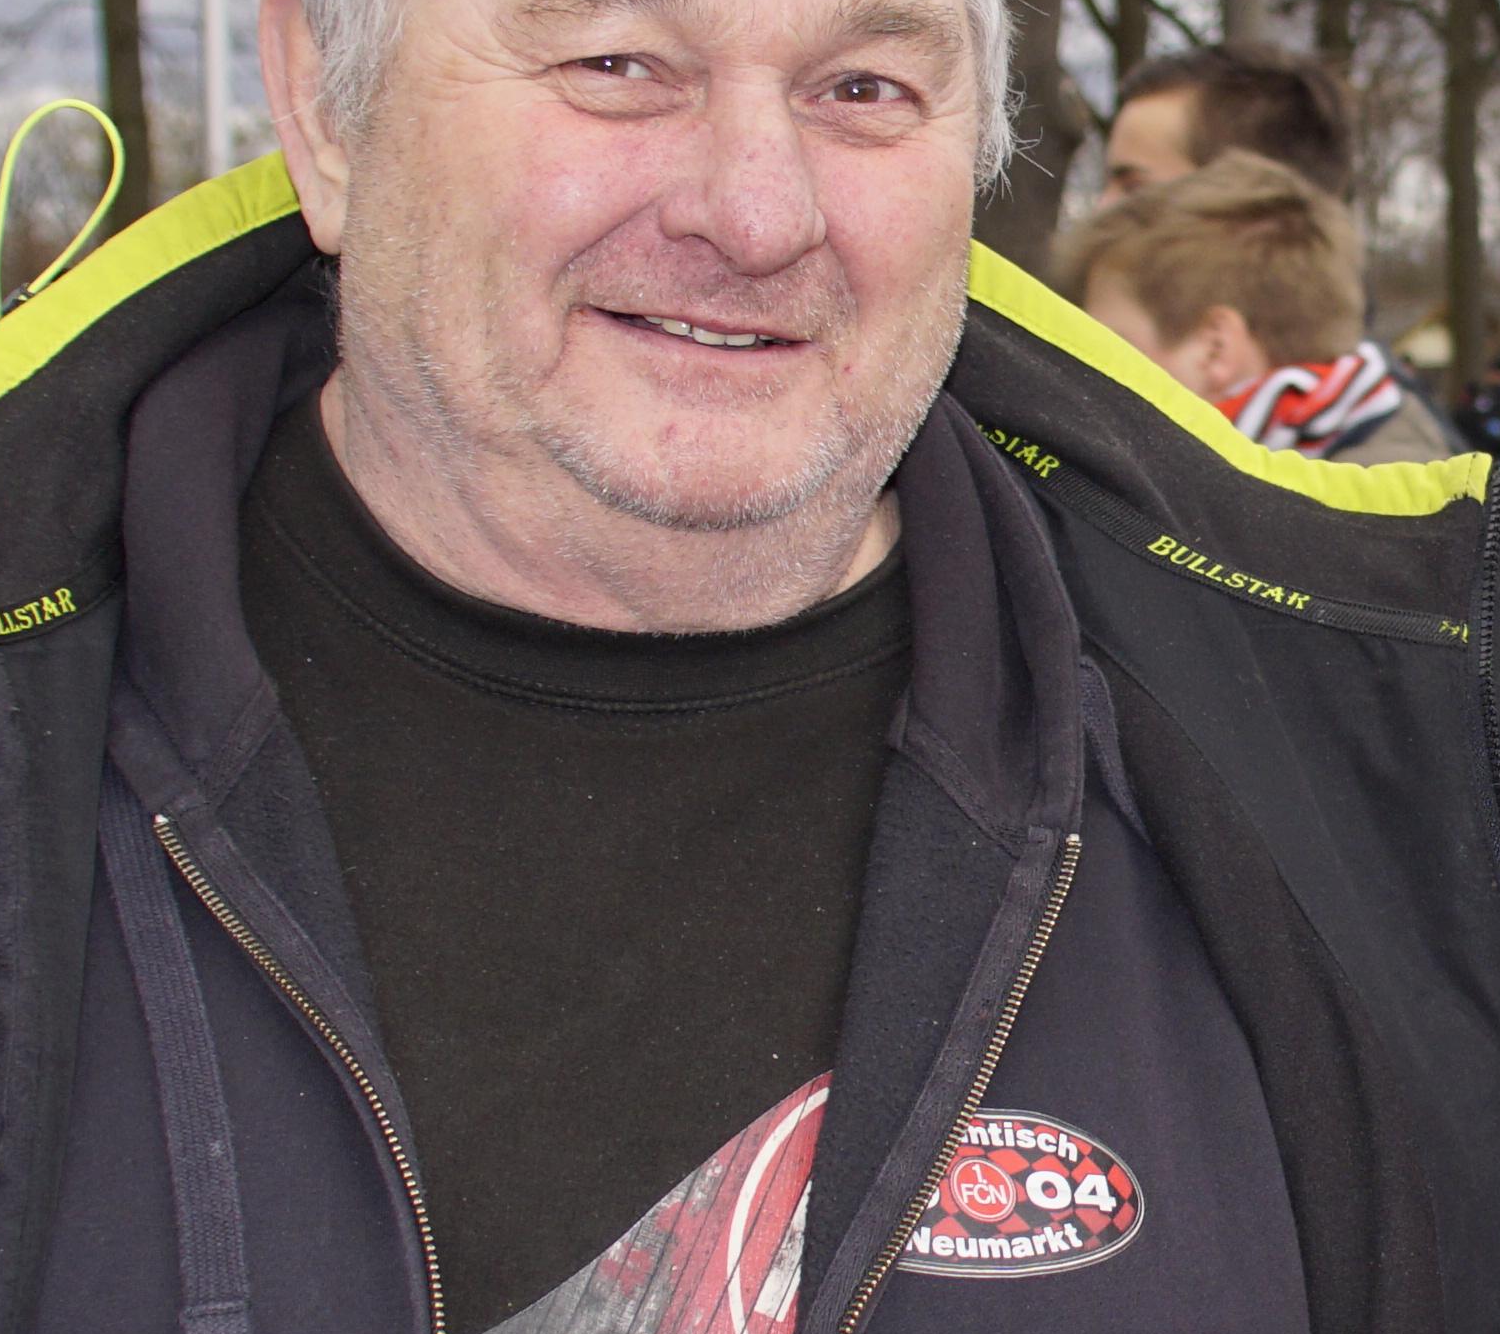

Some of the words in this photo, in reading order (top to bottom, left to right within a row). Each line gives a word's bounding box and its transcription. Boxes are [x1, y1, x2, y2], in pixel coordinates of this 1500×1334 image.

[1147, 534, 1311, 610] BULLSTAR
[960, 1182, 1008, 1206] FCN
[1025, 1170, 1117, 1213] 04
[905, 1222, 1084, 1260] Neumarkt
